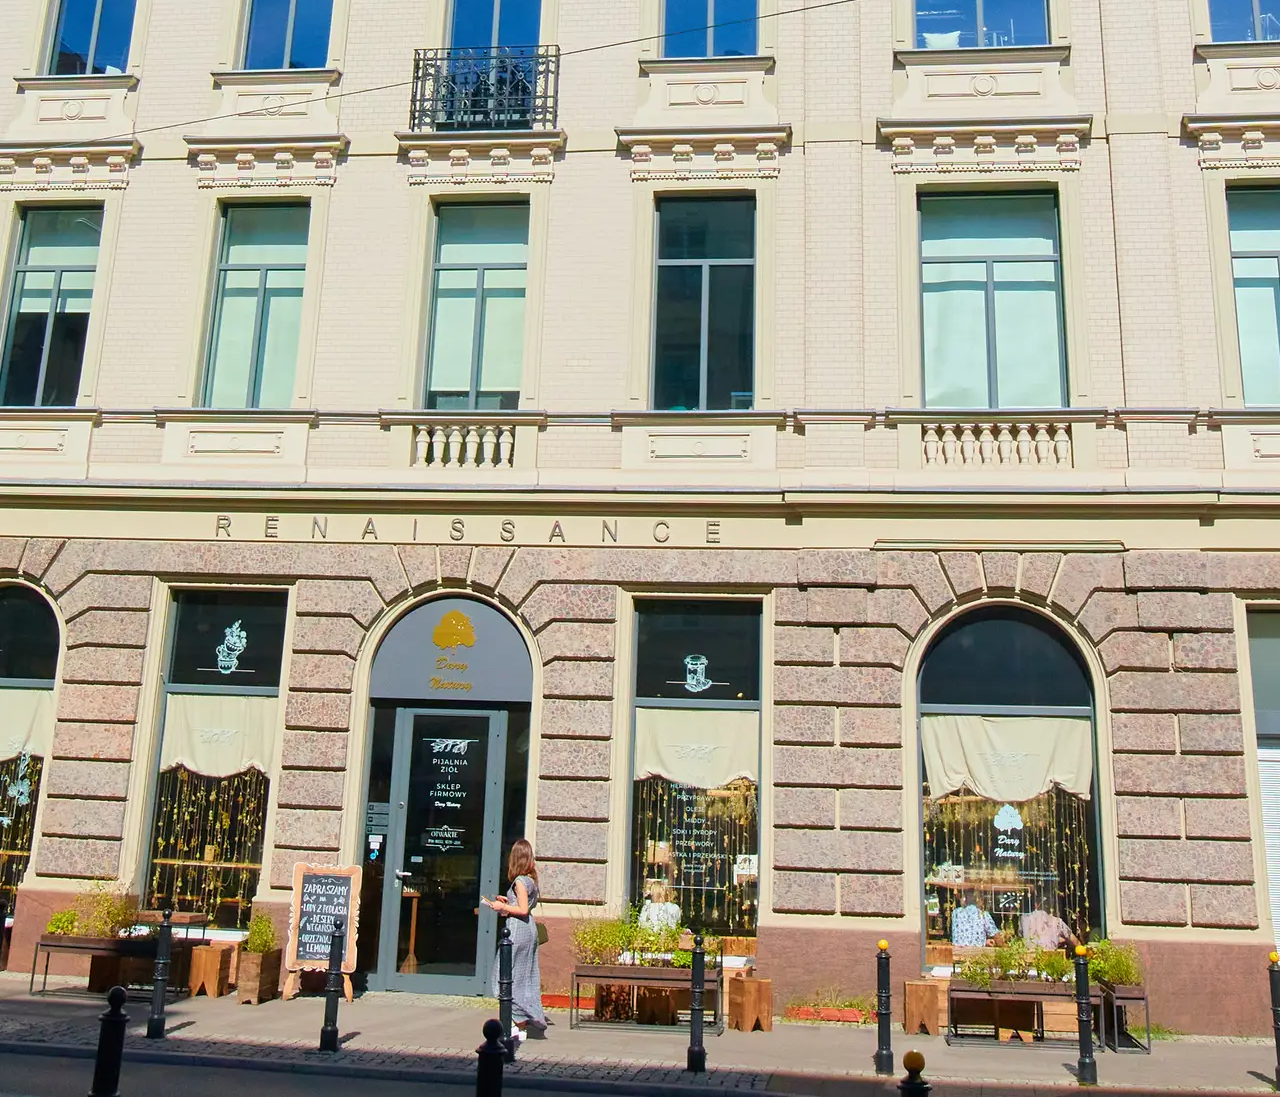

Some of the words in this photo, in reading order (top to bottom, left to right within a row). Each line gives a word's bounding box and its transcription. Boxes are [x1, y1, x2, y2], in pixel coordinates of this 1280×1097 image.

[215, 514, 721, 544] RENAISSANCE
[435, 656, 468, 673] Dary
[430, 677, 473, 692] Natury
[440, 766, 459, 774] ZIÓŁ
[429, 790, 467, 798] FIRMOWY
[997, 835, 1020, 847] Dary
[994, 848, 1024, 859] Natury
[303, 884, 348, 895] ZAPRASZAMY
